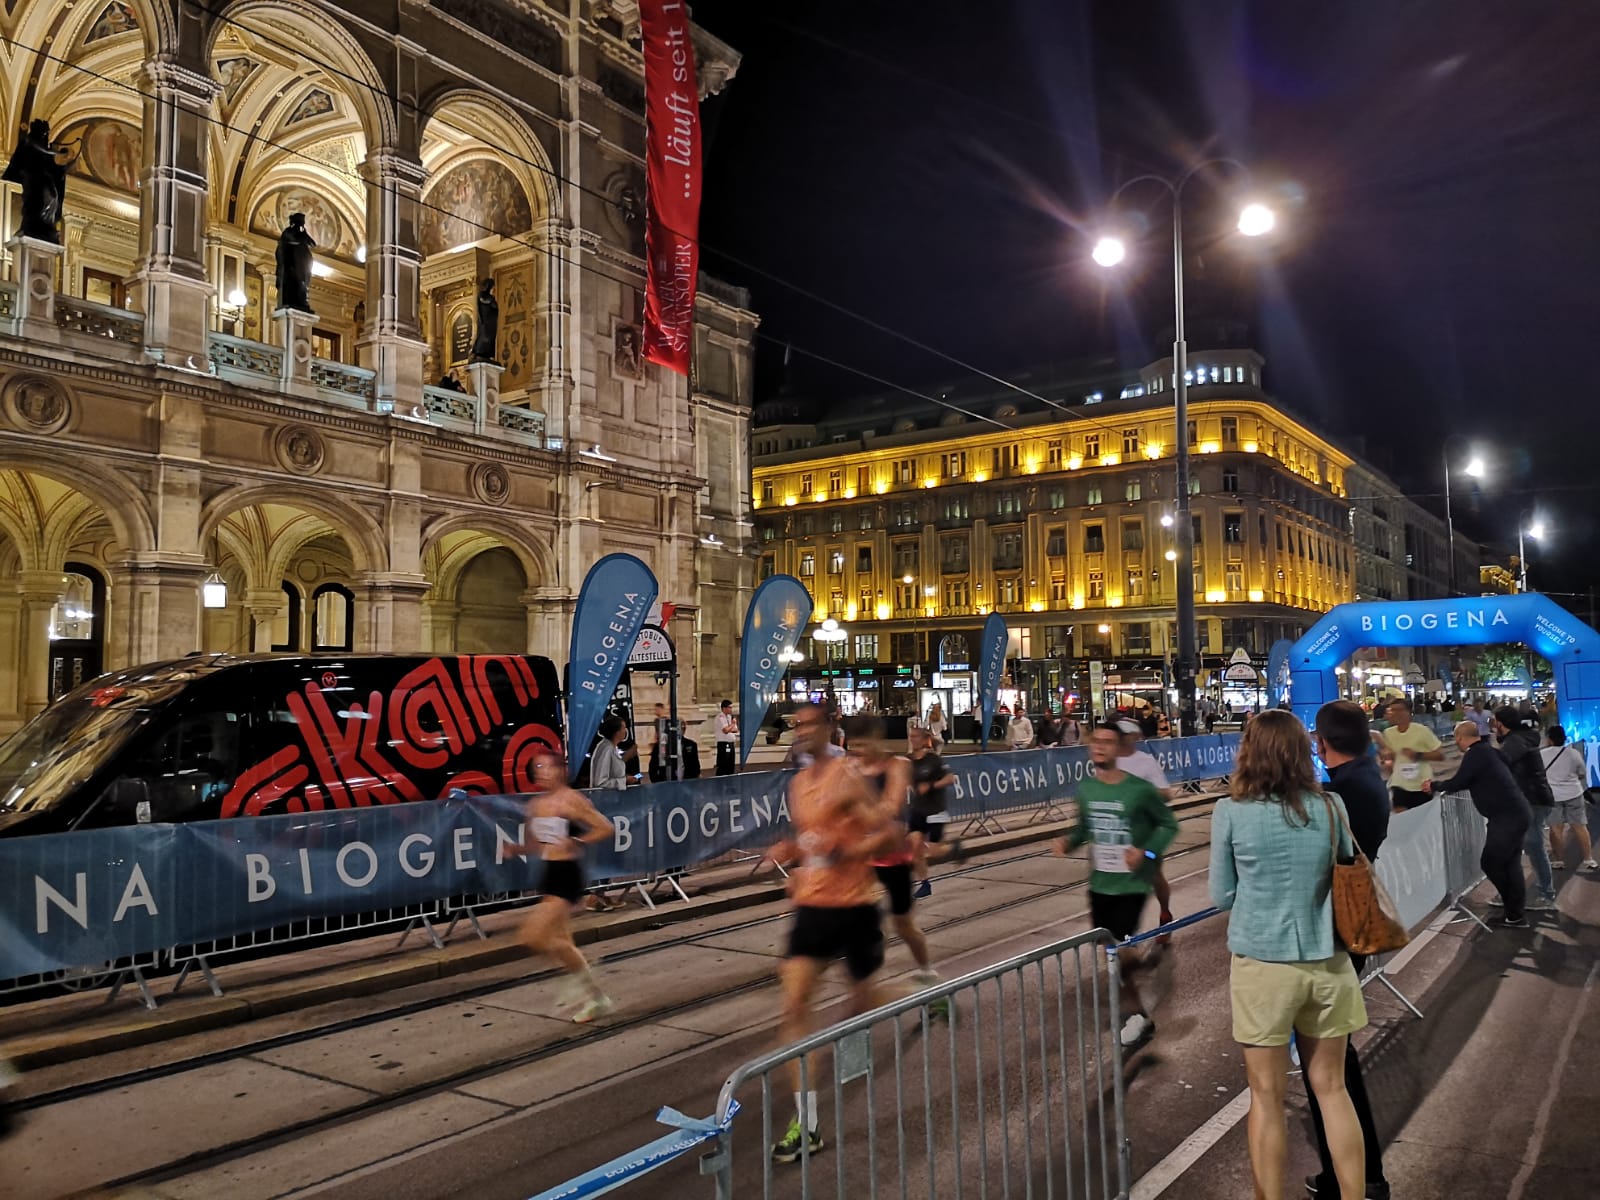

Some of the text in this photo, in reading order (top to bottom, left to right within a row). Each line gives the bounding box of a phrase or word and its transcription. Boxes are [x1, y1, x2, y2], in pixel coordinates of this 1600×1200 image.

[665, 25, 687, 82] seit
[665, 91, 696, 167] läuft
[673, 242, 692, 353] STAATSOPER
[581, 593, 638, 691] BIOGENA
[1361, 608, 1509, 631] BIOGENA
[1535, 622, 1566, 645] YOURSELF
[1536, 614, 1576, 644] WELCOME TO
[631, 651, 668, 662] ALTESTELLE
[750, 614, 790, 690] BIOGEN
[953, 760, 1097, 800] BIOGENA BIOG
[1158, 745, 1238, 770] GENA BIOGEN
[35, 791, 792, 934] NA BIOGEN BIOGENA
